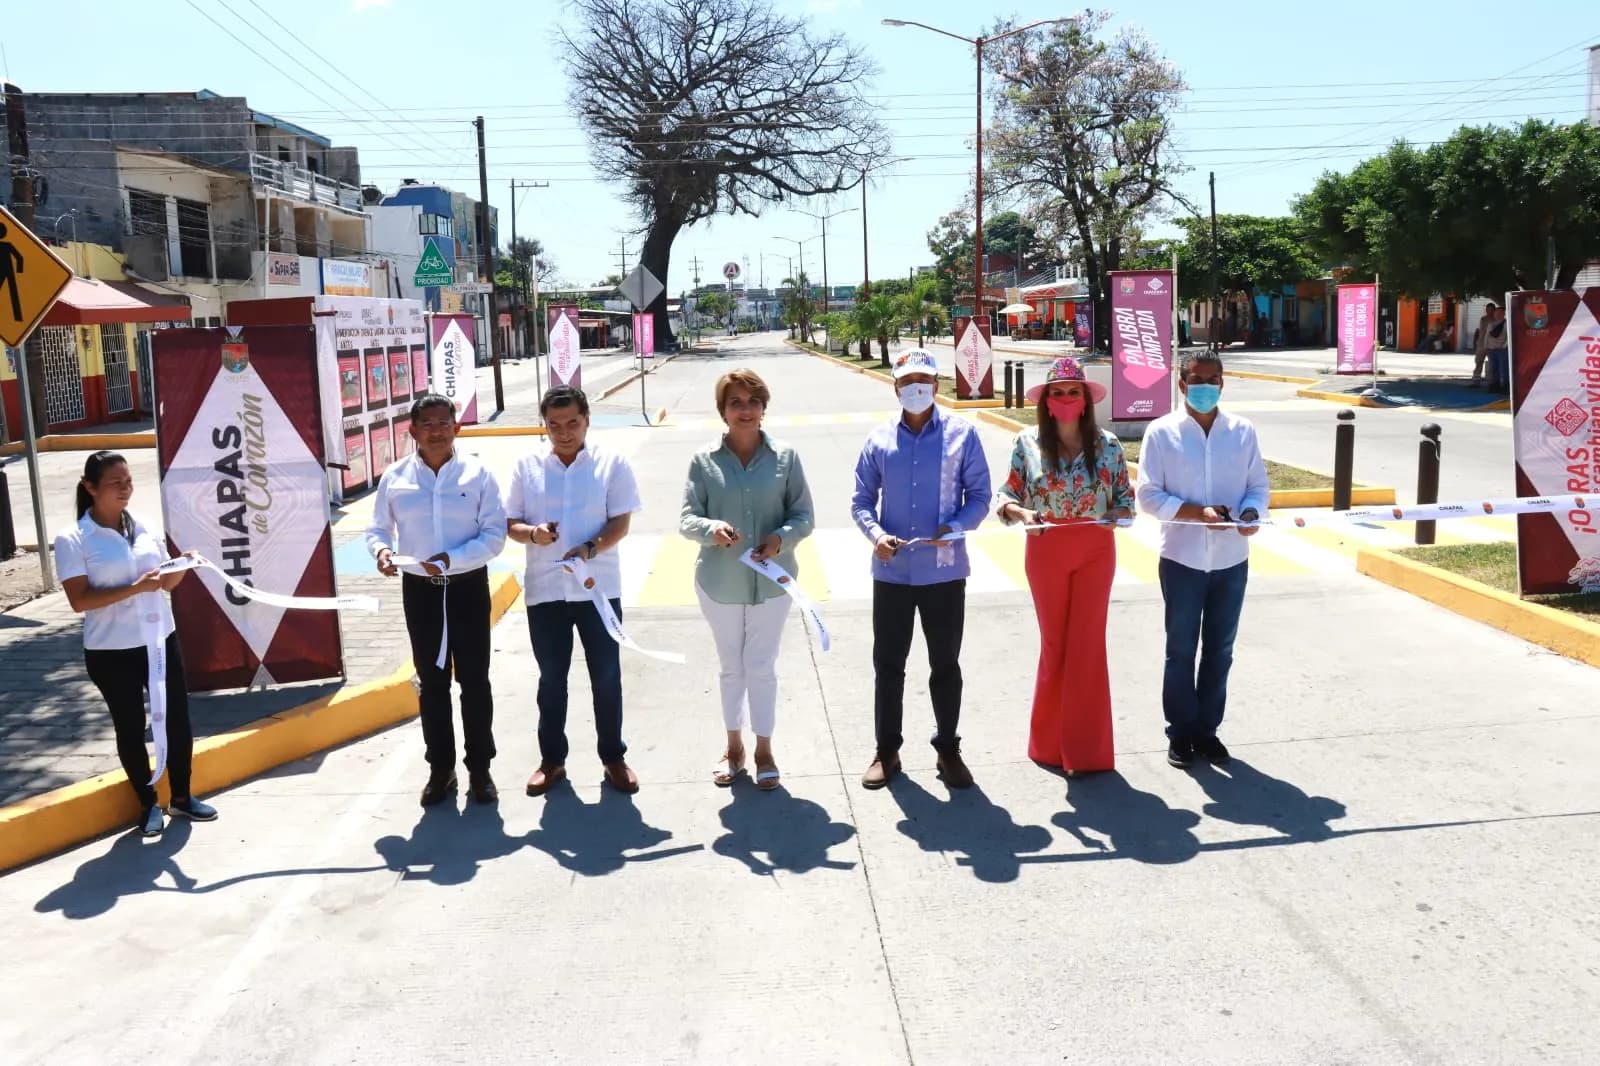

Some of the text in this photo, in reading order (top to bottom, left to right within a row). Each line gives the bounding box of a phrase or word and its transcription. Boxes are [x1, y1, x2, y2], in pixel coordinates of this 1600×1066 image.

[444, 341, 456, 397] CHIAPAS
[1114, 307, 1146, 367] PALABRA
[1136, 310, 1166, 370] CUMPLIDA
[237, 393, 272, 534] de Corazón
[1567, 447, 1597, 534] ¡ORAS
[212, 425, 255, 606] CHIAPAS
